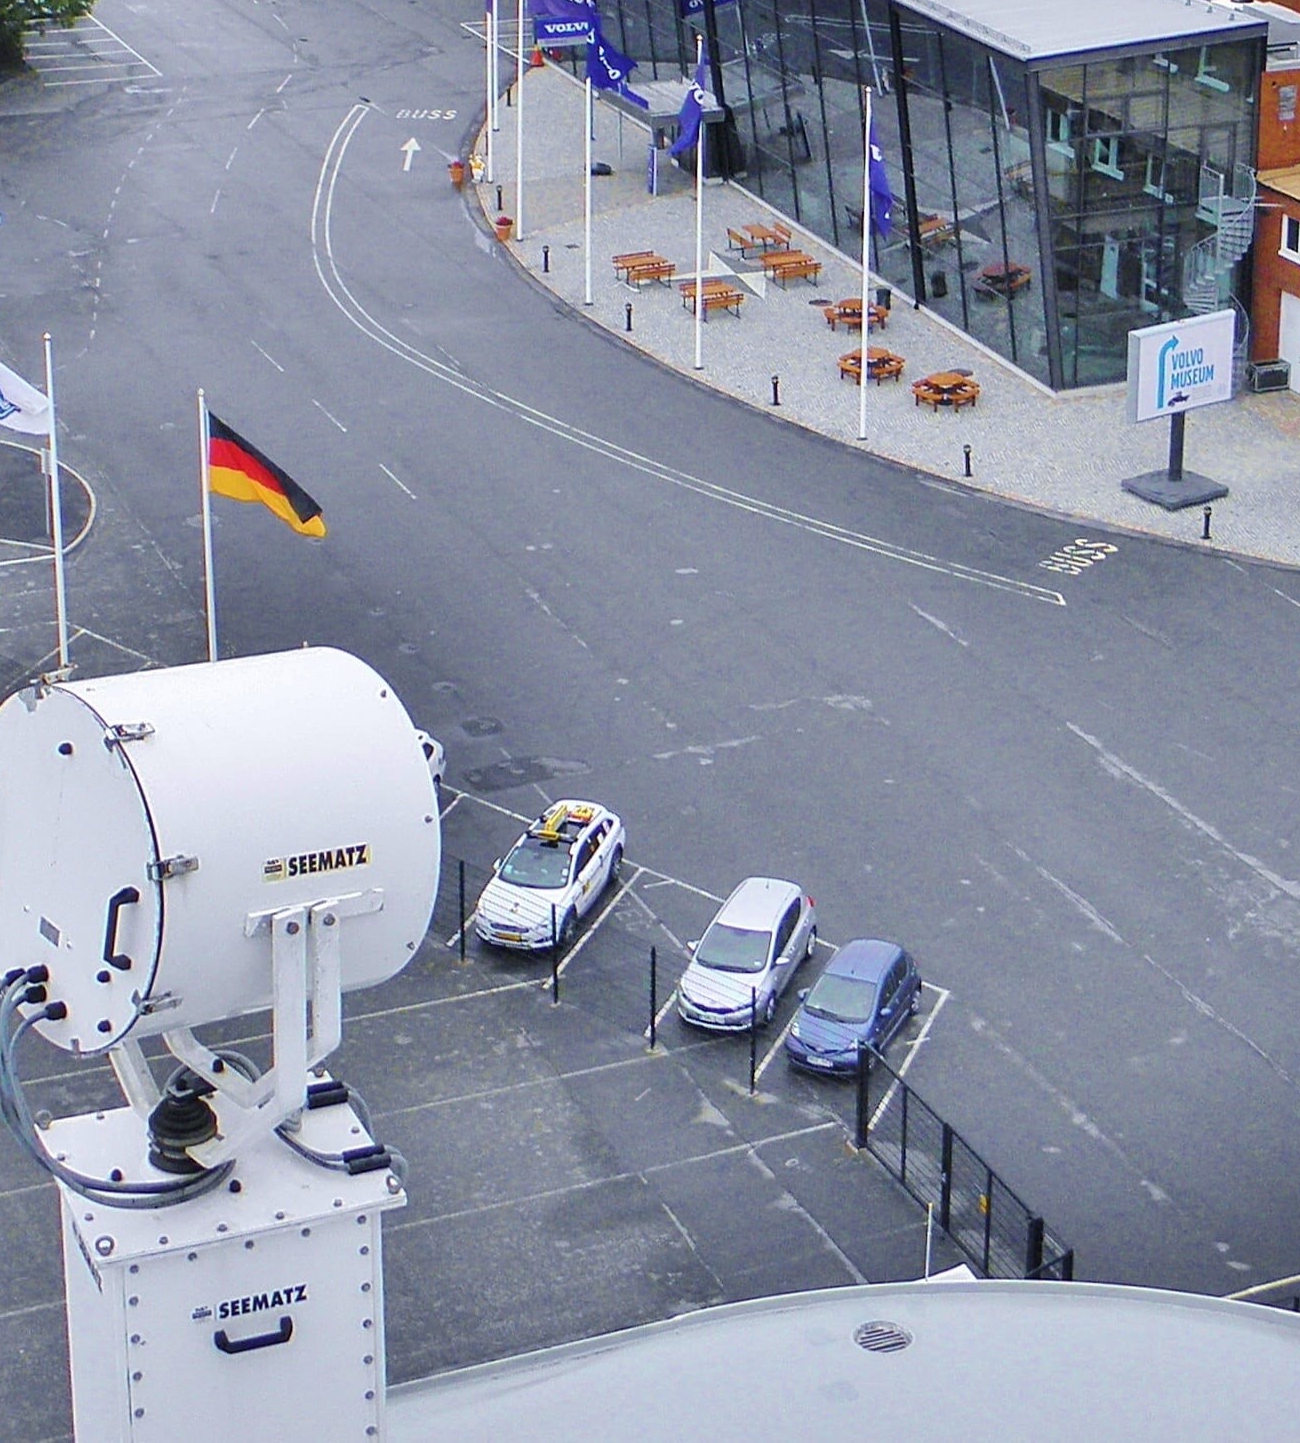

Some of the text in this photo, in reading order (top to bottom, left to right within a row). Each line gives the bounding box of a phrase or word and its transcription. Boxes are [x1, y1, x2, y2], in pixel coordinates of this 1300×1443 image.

[396, 109, 458, 120] BUSS
[1171, 348, 1204, 371] VOLVO
[1171, 365, 1215, 389] MUSEUM
[1039, 538, 1118, 575] BUSS
[288, 844, 367, 877] SEEMATZ
[218, 1284, 308, 1319] SEEMATZ
